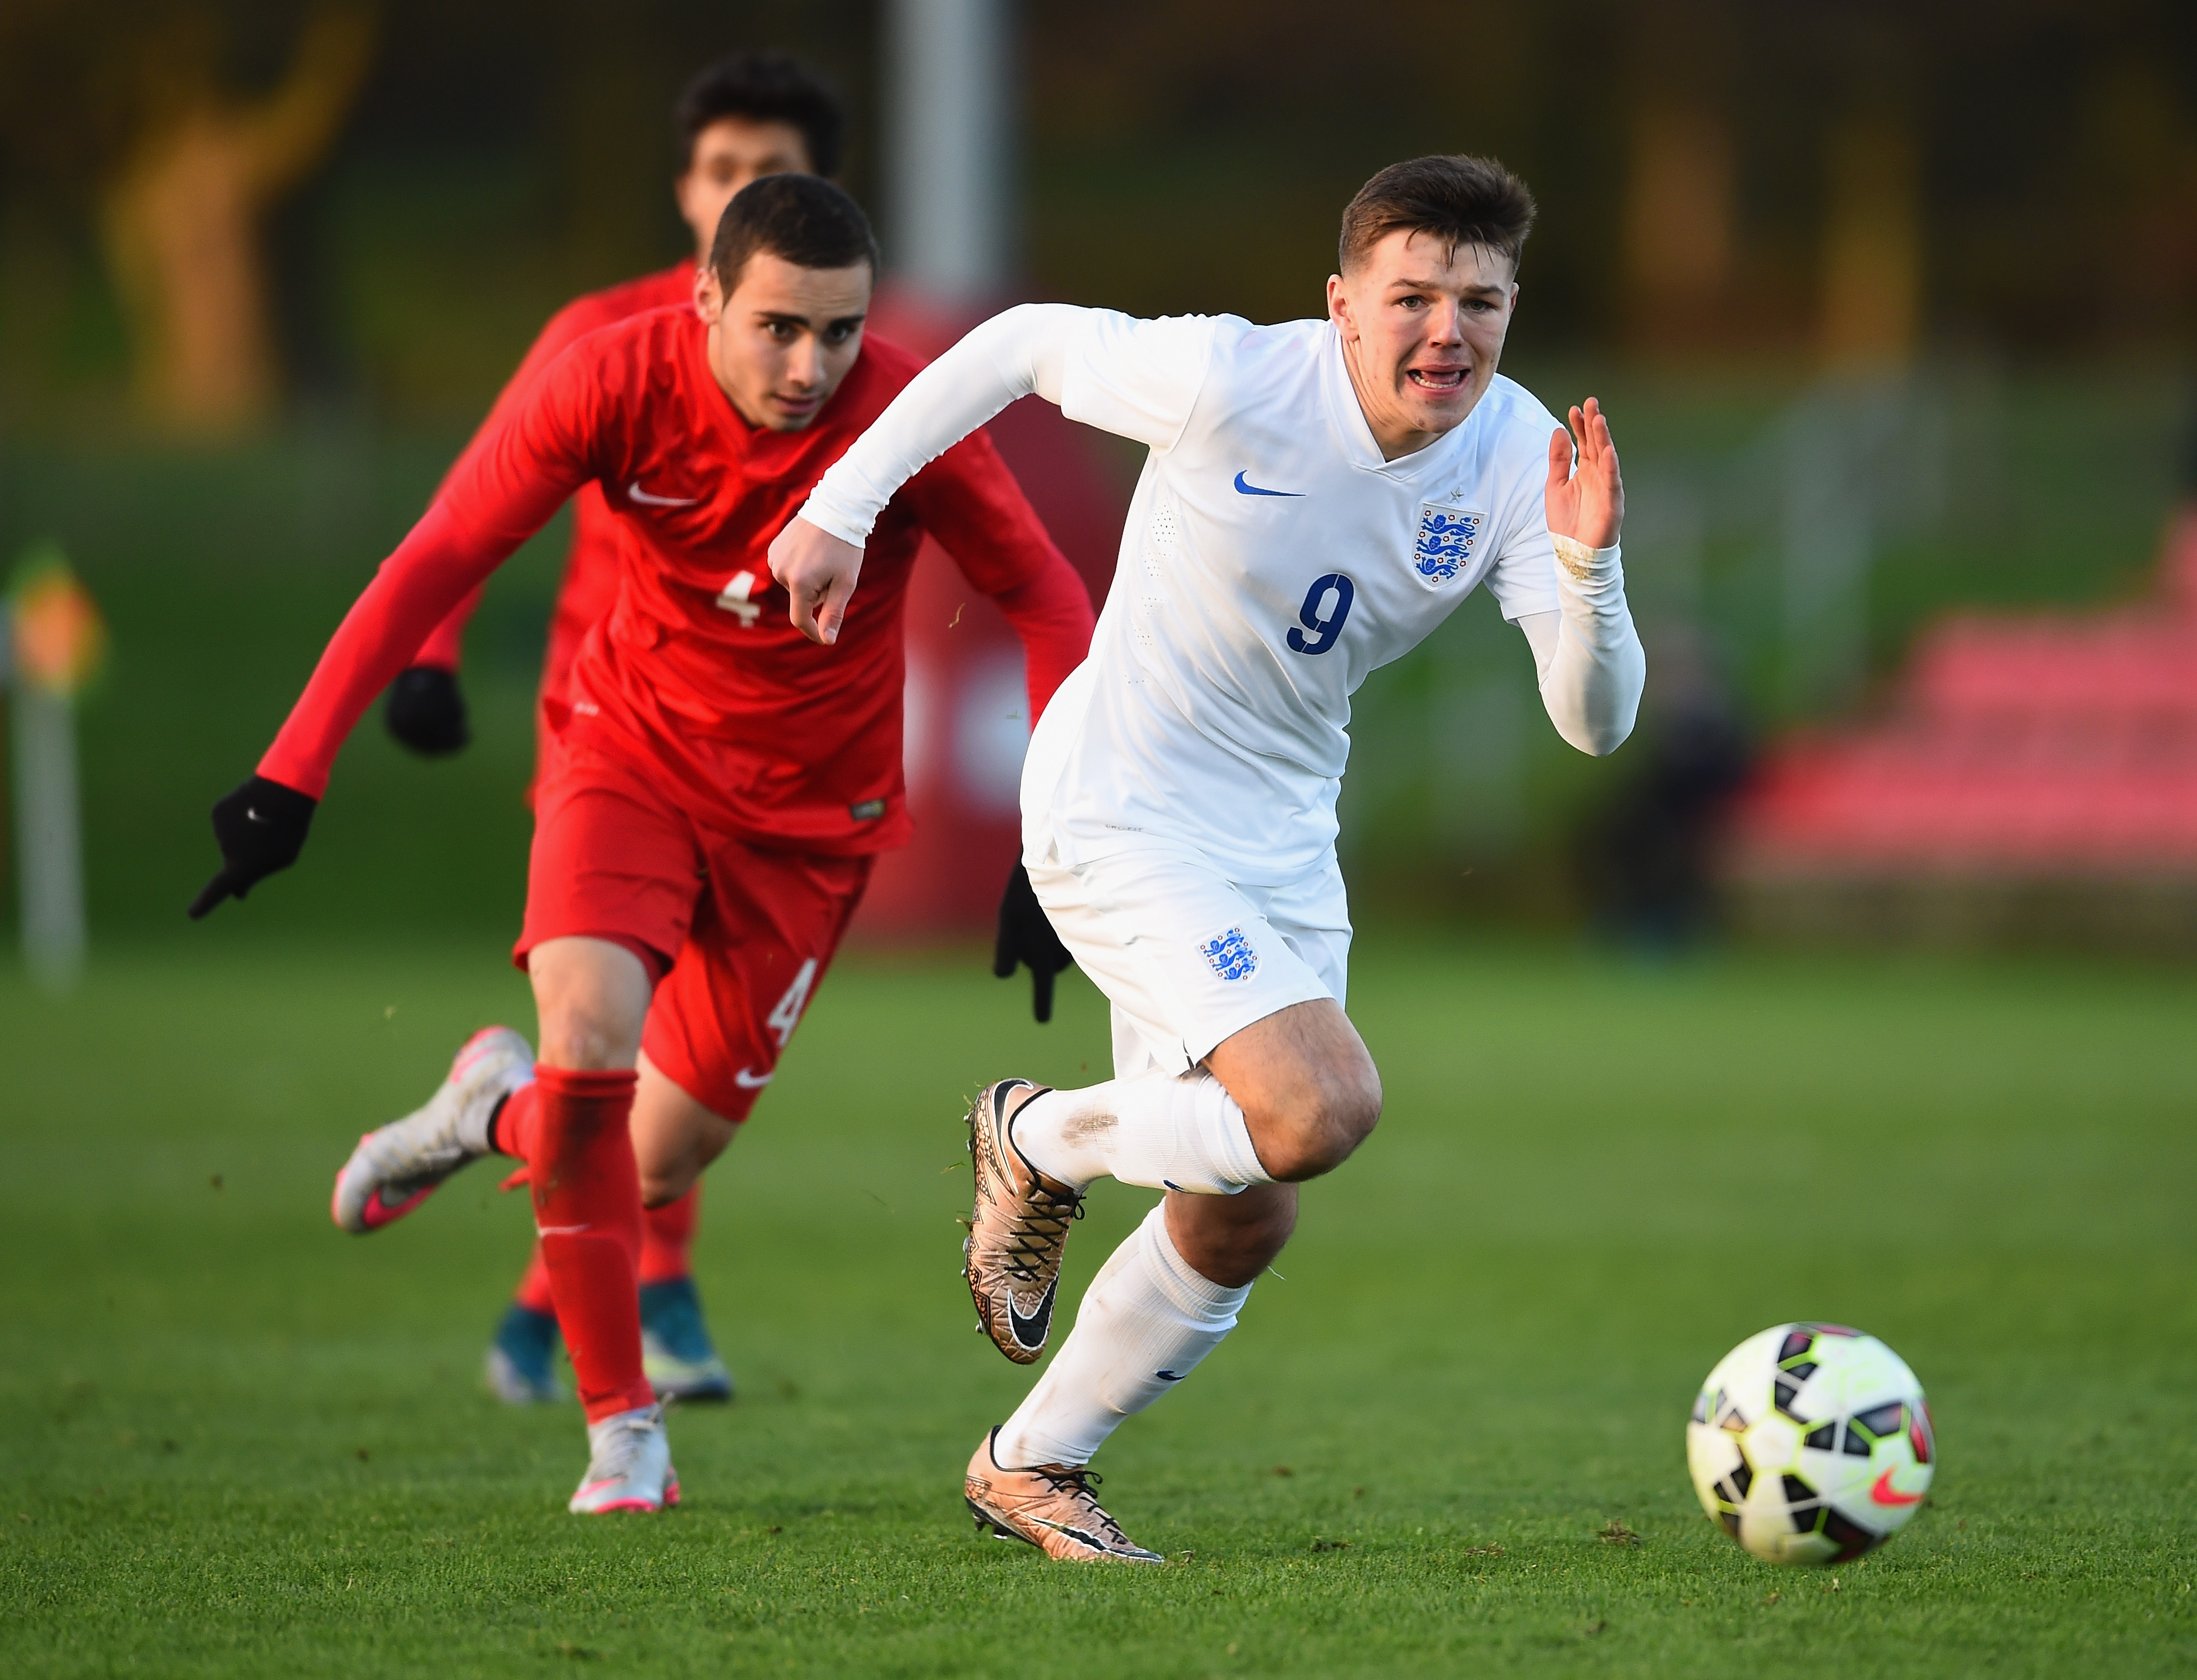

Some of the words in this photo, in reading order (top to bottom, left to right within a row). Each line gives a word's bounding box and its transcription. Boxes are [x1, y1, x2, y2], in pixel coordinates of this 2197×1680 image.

[716, 571, 760, 628] 4
[1286, 573, 1355, 655] 9
[766, 957, 818, 1048] 4
